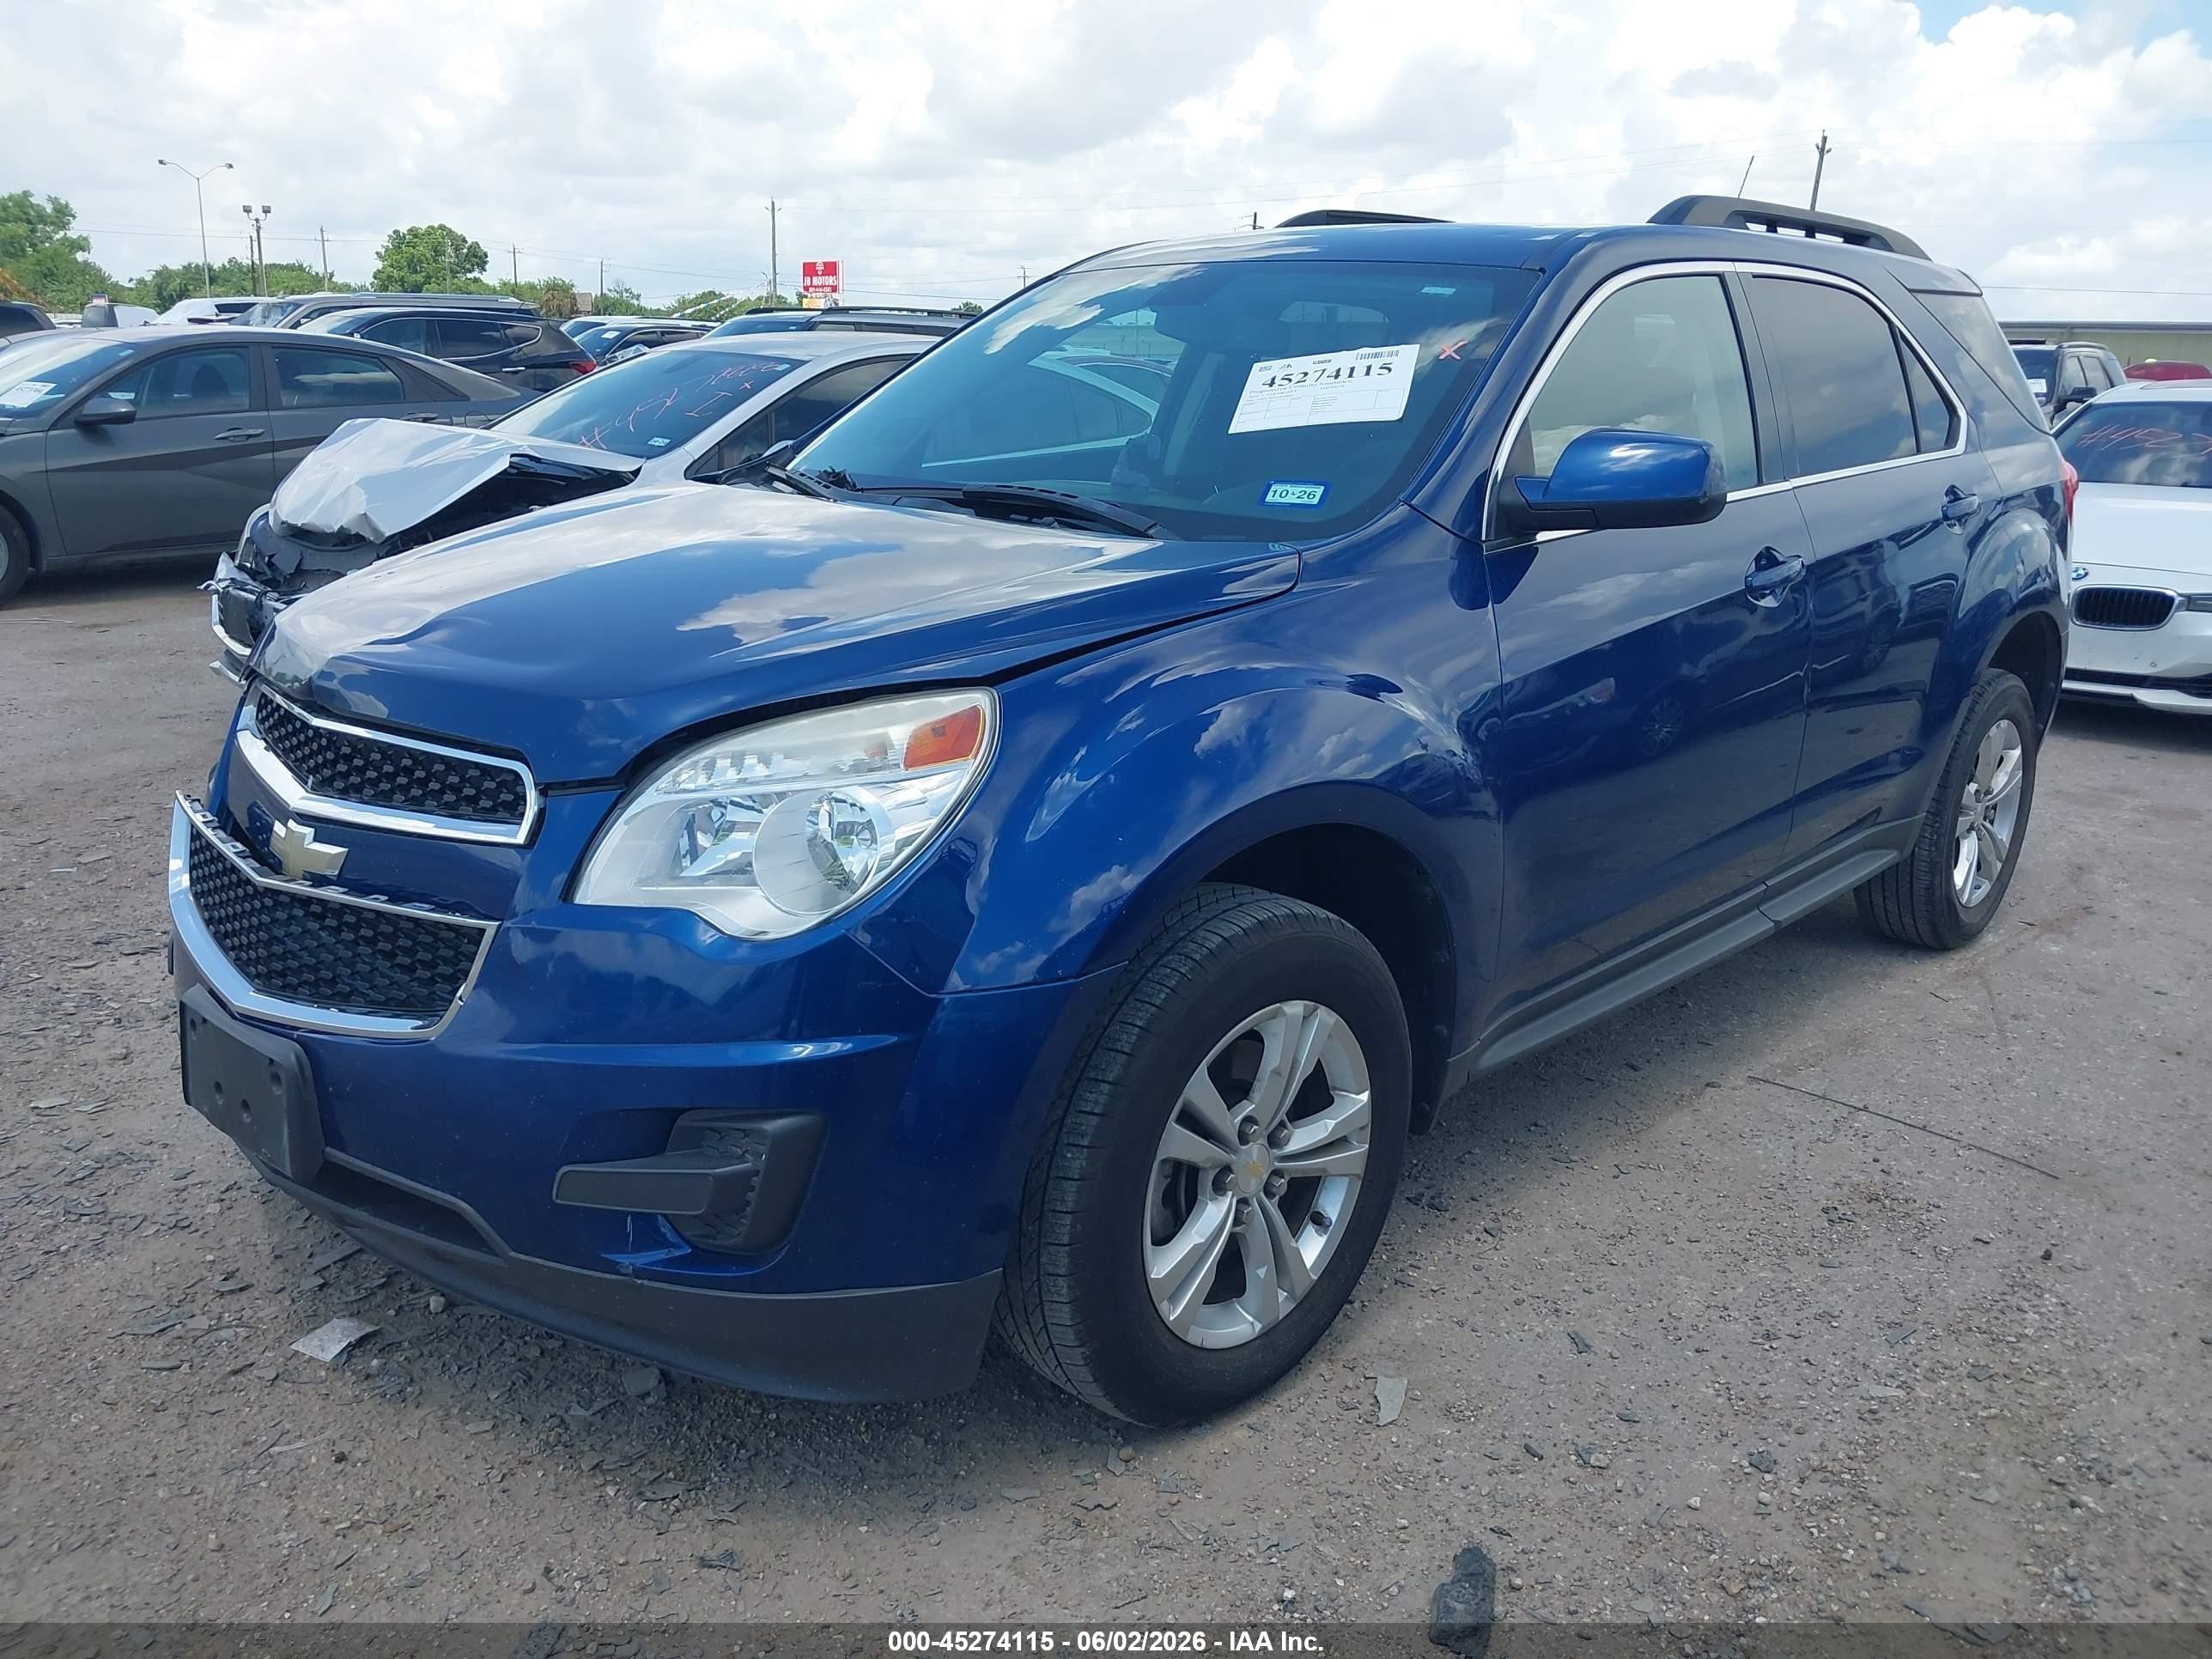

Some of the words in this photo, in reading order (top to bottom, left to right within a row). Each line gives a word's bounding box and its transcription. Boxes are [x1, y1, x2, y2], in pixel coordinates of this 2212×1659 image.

[804, 276, 811, 286] JB
[812, 275, 837, 286] MOTORS
[1261, 362, 1395, 388] 45274115
